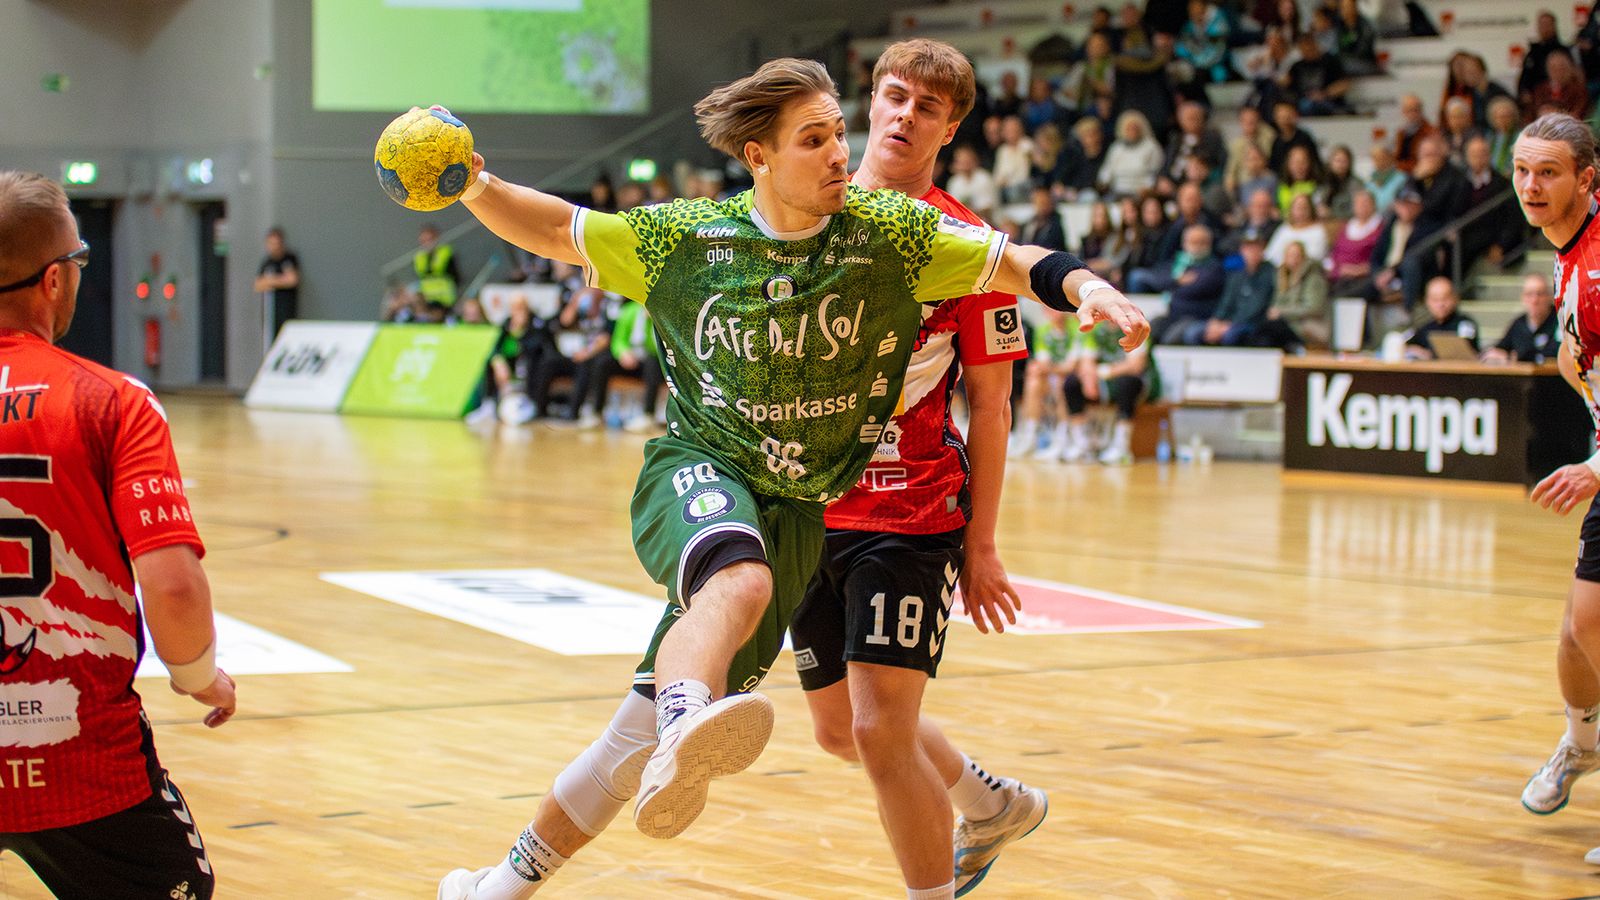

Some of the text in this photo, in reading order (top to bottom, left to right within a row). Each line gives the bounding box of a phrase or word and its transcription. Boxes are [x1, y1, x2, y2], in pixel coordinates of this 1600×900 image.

[706, 245, 734, 267] gbg
[0, 391, 42, 424] KT
[735, 393, 858, 427] Sparkasse
[1307, 372, 1498, 473] Kempa
[865, 592, 924, 649] 18
